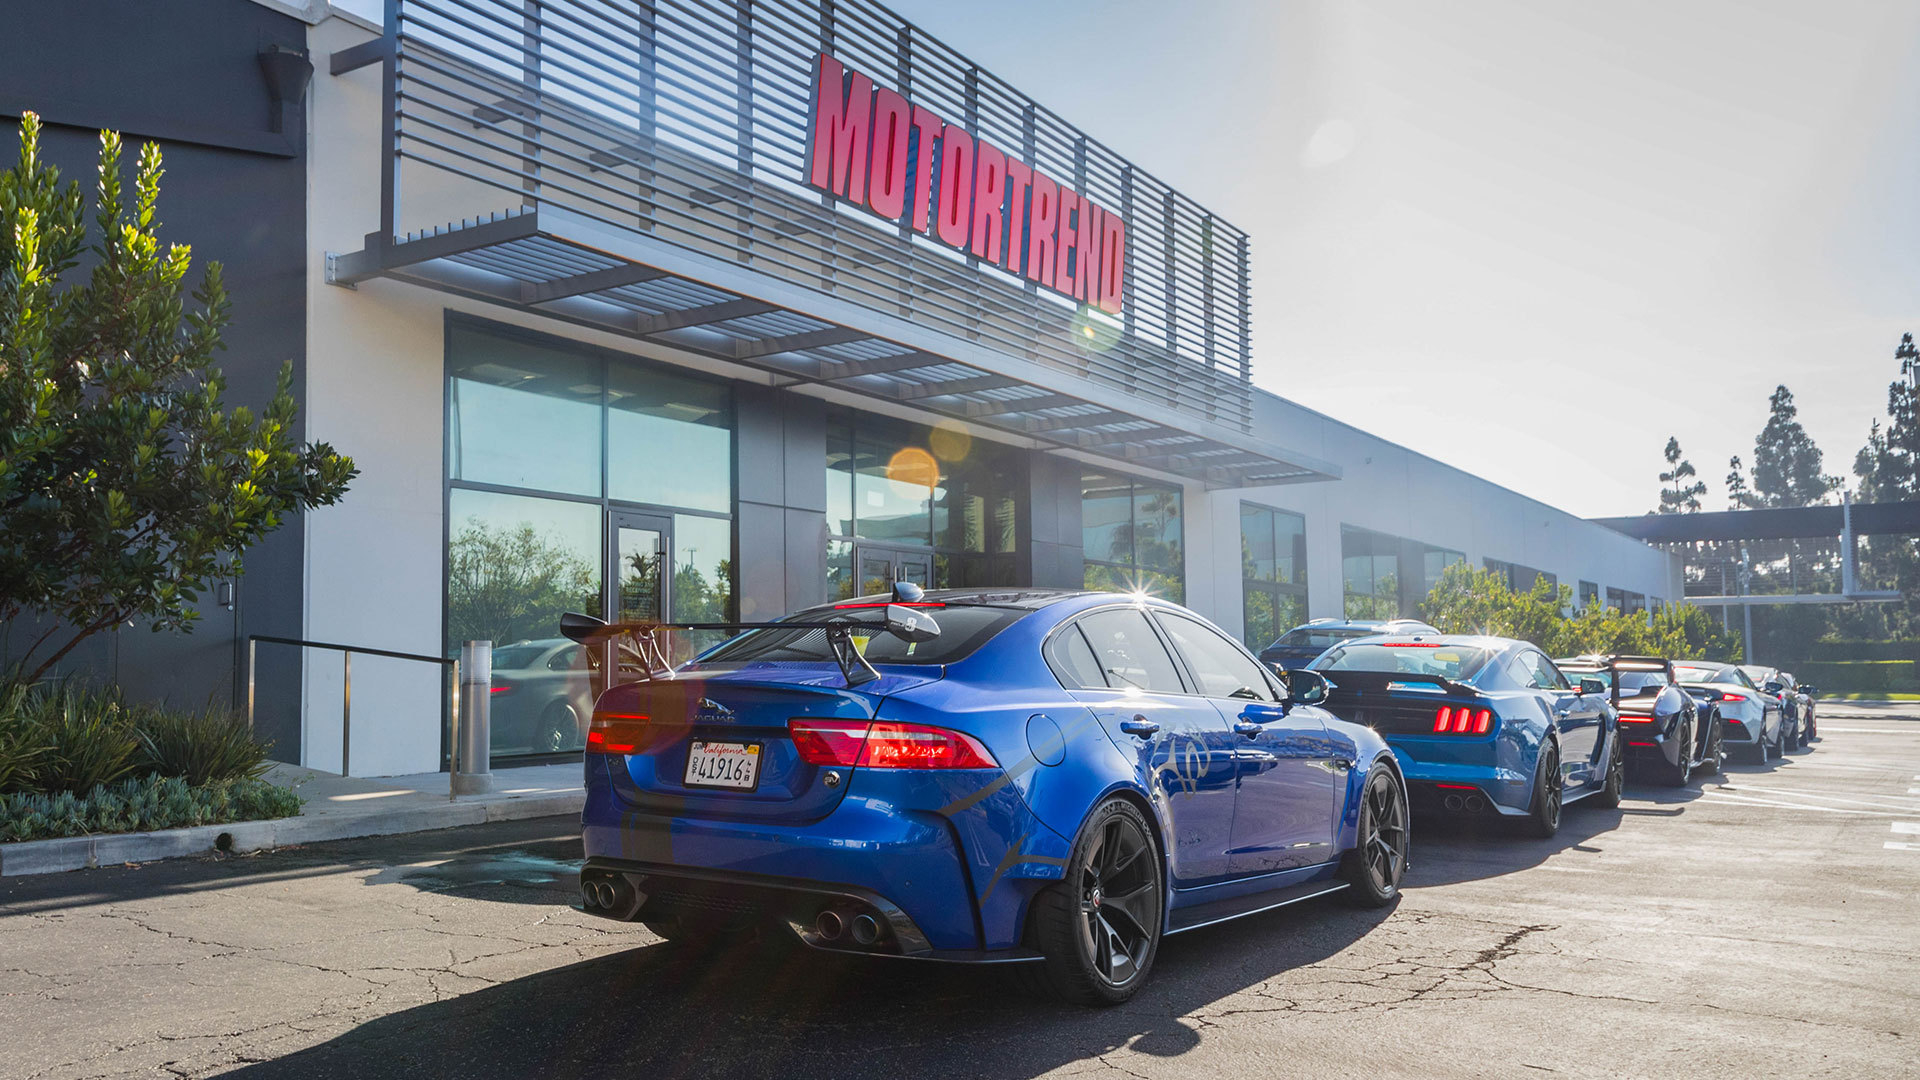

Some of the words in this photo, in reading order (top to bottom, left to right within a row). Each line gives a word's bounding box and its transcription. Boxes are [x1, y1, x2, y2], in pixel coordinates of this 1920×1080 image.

[808, 52, 1125, 315] MOTORTREND
[704, 743, 747, 757] California
[699, 757, 745, 780] 41916
